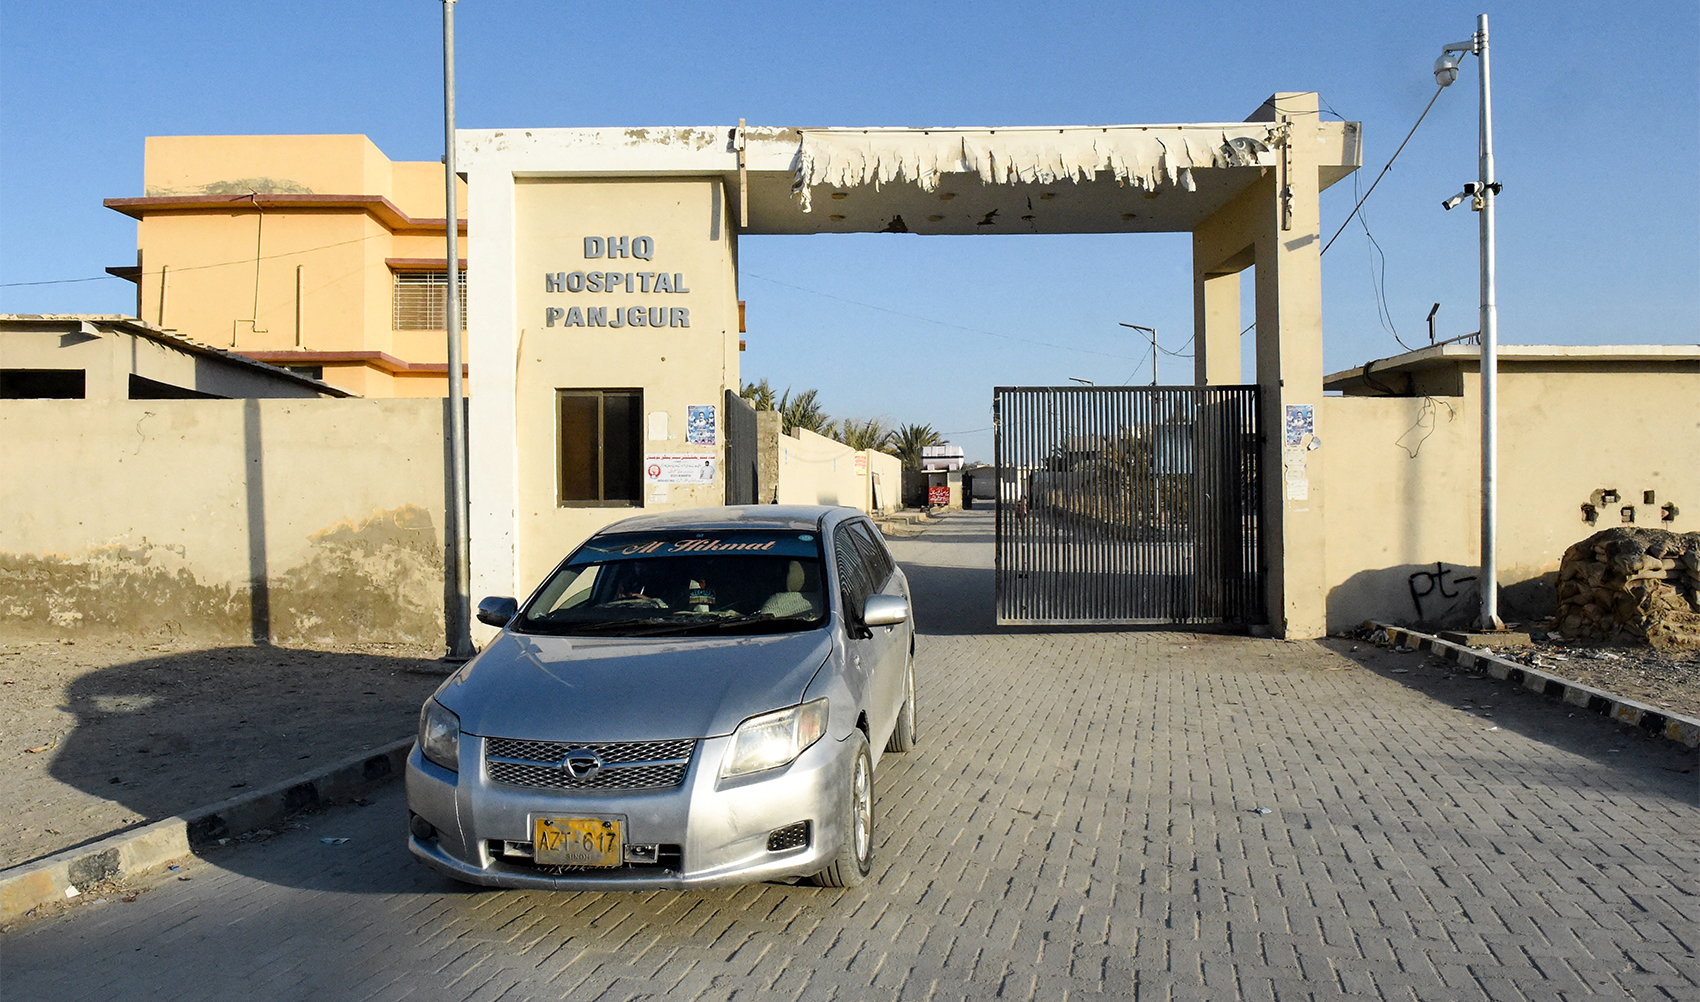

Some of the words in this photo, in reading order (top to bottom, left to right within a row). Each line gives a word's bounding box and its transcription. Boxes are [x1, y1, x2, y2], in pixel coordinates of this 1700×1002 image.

[584, 236, 654, 261] DHQ
[546, 271, 690, 293] HOSPITAL
[546, 306, 690, 328] PANJGUR
[668, 538, 776, 553] Hikmat
